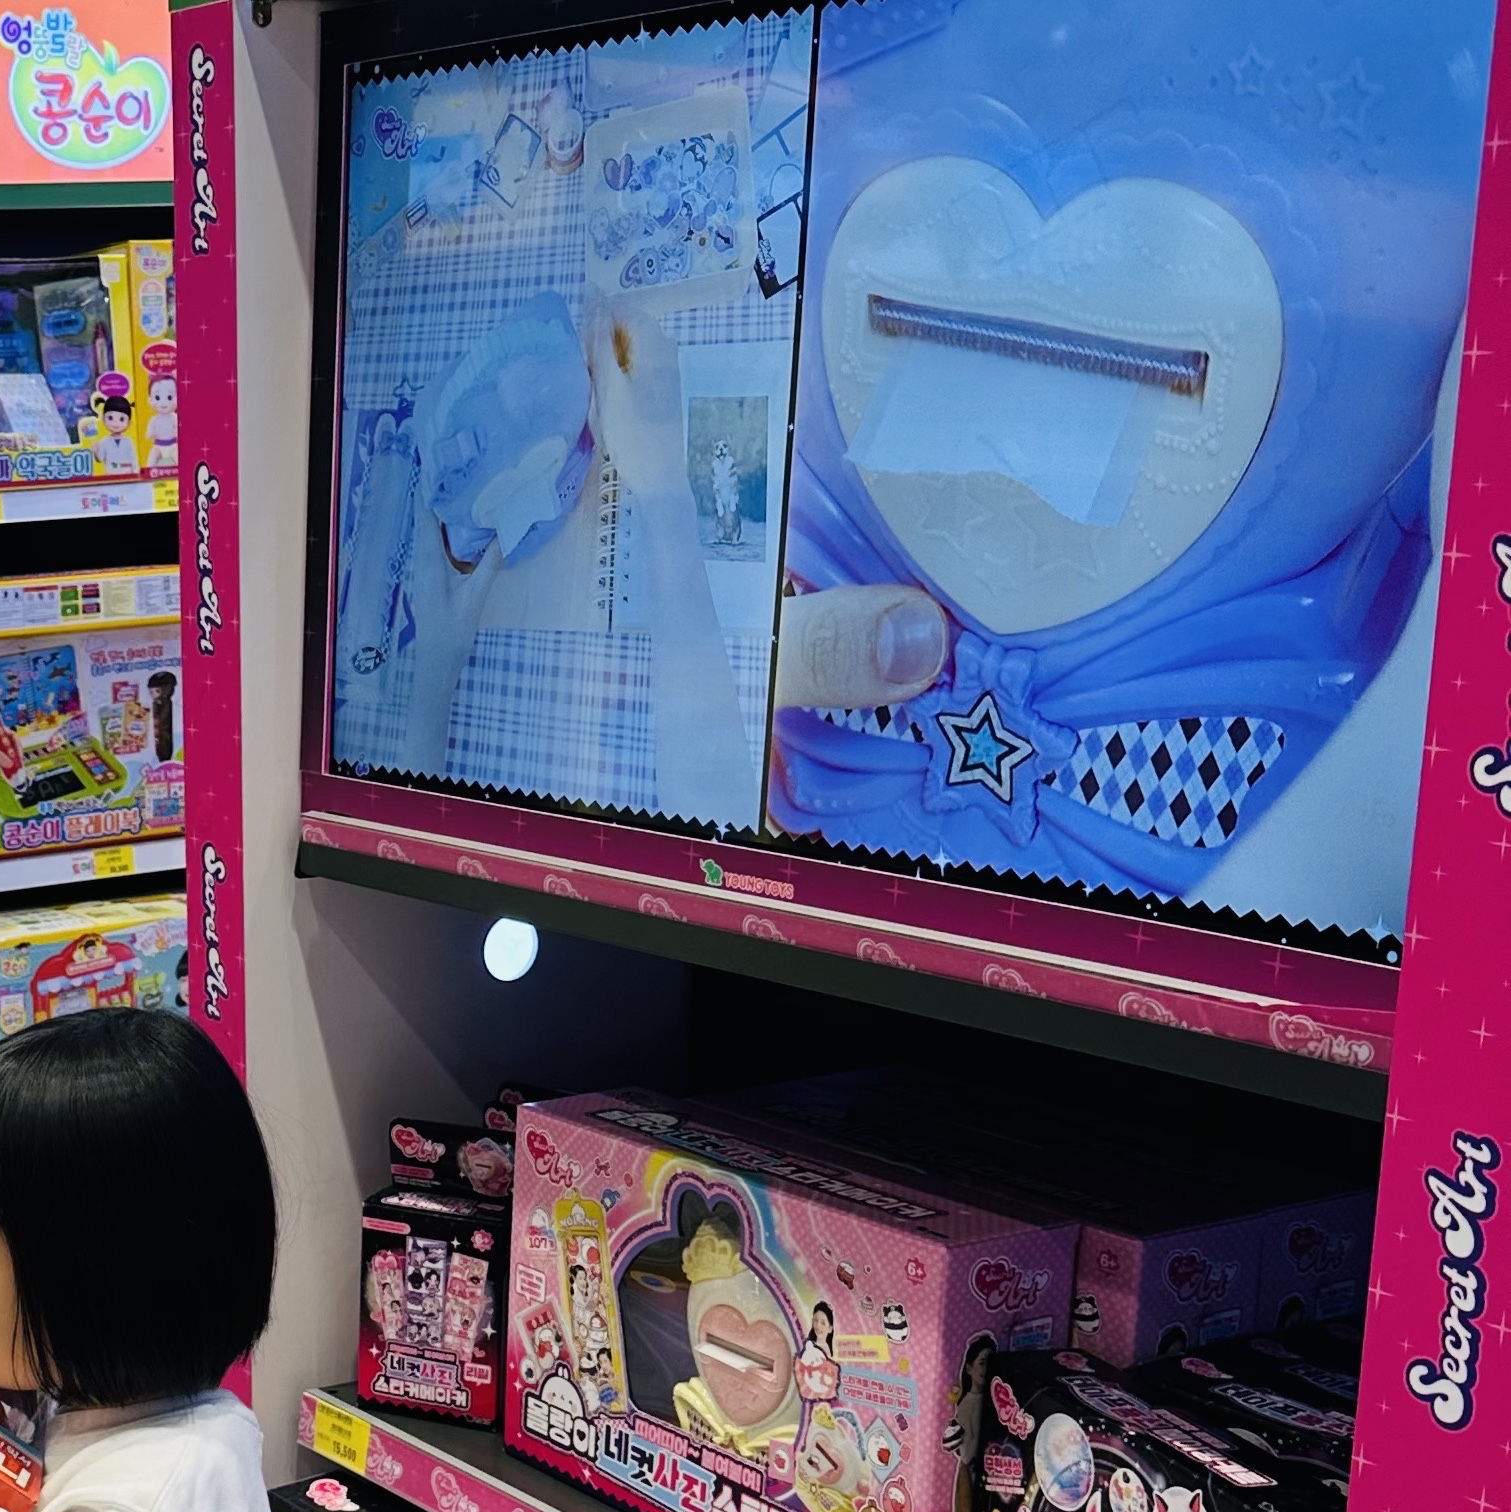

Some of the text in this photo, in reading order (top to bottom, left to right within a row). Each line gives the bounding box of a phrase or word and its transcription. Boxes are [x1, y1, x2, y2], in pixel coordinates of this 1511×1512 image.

[0, 12, 85, 67] 엉뚱발랄
[34, 71, 151, 146] 콩순이
[190, 47, 217, 254] Secret Art
[14, 450, 93, 482] 약국놀이
[197, 464, 222, 653] Secret Art
[2, 806, 139, 849] 콩순이 플레이북
[724, 871, 795, 900] YOUNG TOYS
[204, 845, 229, 1018] Secret Art
[906, 1262, 925, 1279] 6+
[1408, 1137, 1492, 1426] Secret Art
[374, 1375, 468, 1409] 스티커메이커
[388, 1353, 456, 1388] 네컷사진
[526, 1397, 597, 1460] 몰랑이
